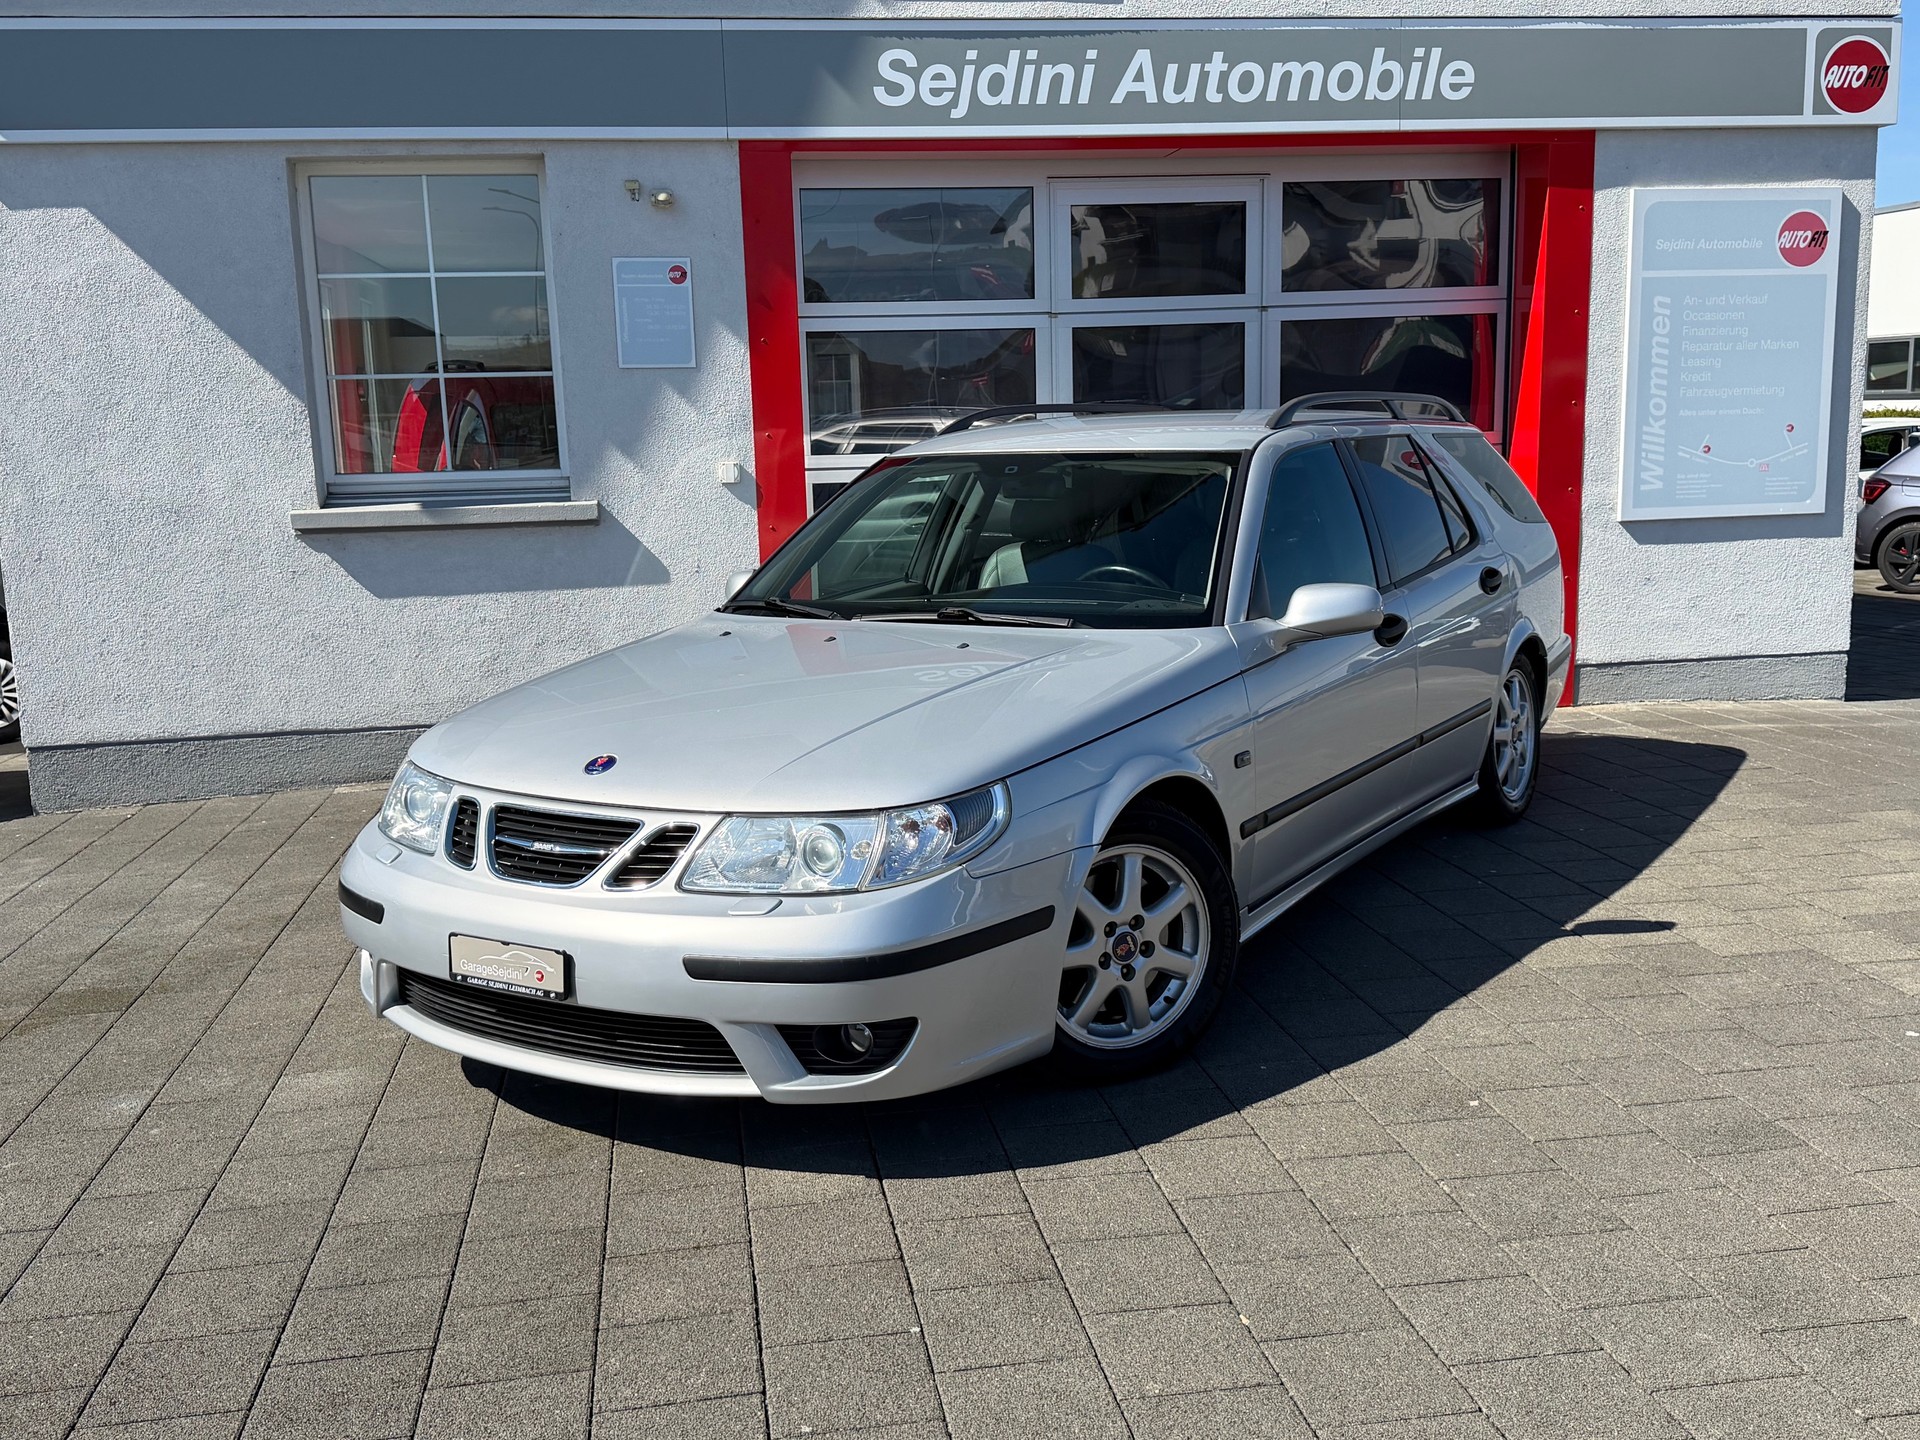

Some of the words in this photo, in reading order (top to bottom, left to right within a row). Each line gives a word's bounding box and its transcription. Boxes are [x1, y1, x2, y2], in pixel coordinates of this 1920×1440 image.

[873, 49, 1097, 118] Sejdini
[1111, 47, 1475, 104] Automobile
[1824, 65, 1890, 88] AUTOFIT
[1656, 239, 1695, 251] Sejdini
[1697, 238, 1763, 249] Automobile
[1778, 231, 1829, 248] AUTOFIT
[1683, 295, 1703, 306] An-
[1705, 294, 1725, 305] und
[1728, 293, 1768, 305] Verkauf
[1683, 310, 1745, 321] Occasionen
[1682, 325, 1748, 337] Finanzierung
[1681, 341, 1733, 353] Reparatur
[1736, 340, 1758, 350] aller
[1760, 339, 1799, 350] Marken
[1681, 356, 1722, 368] Leasing
[1680, 371, 1712, 382] Kredit
[1640, 295, 1671, 491] Willkommen
[1680, 385, 1785, 398] Fahrzeugvermietung
[460, 959, 522, 980] GarageSejdini
[467, 976, 488, 987] GARAGE
[488, 980, 508, 990] SEJDINI
